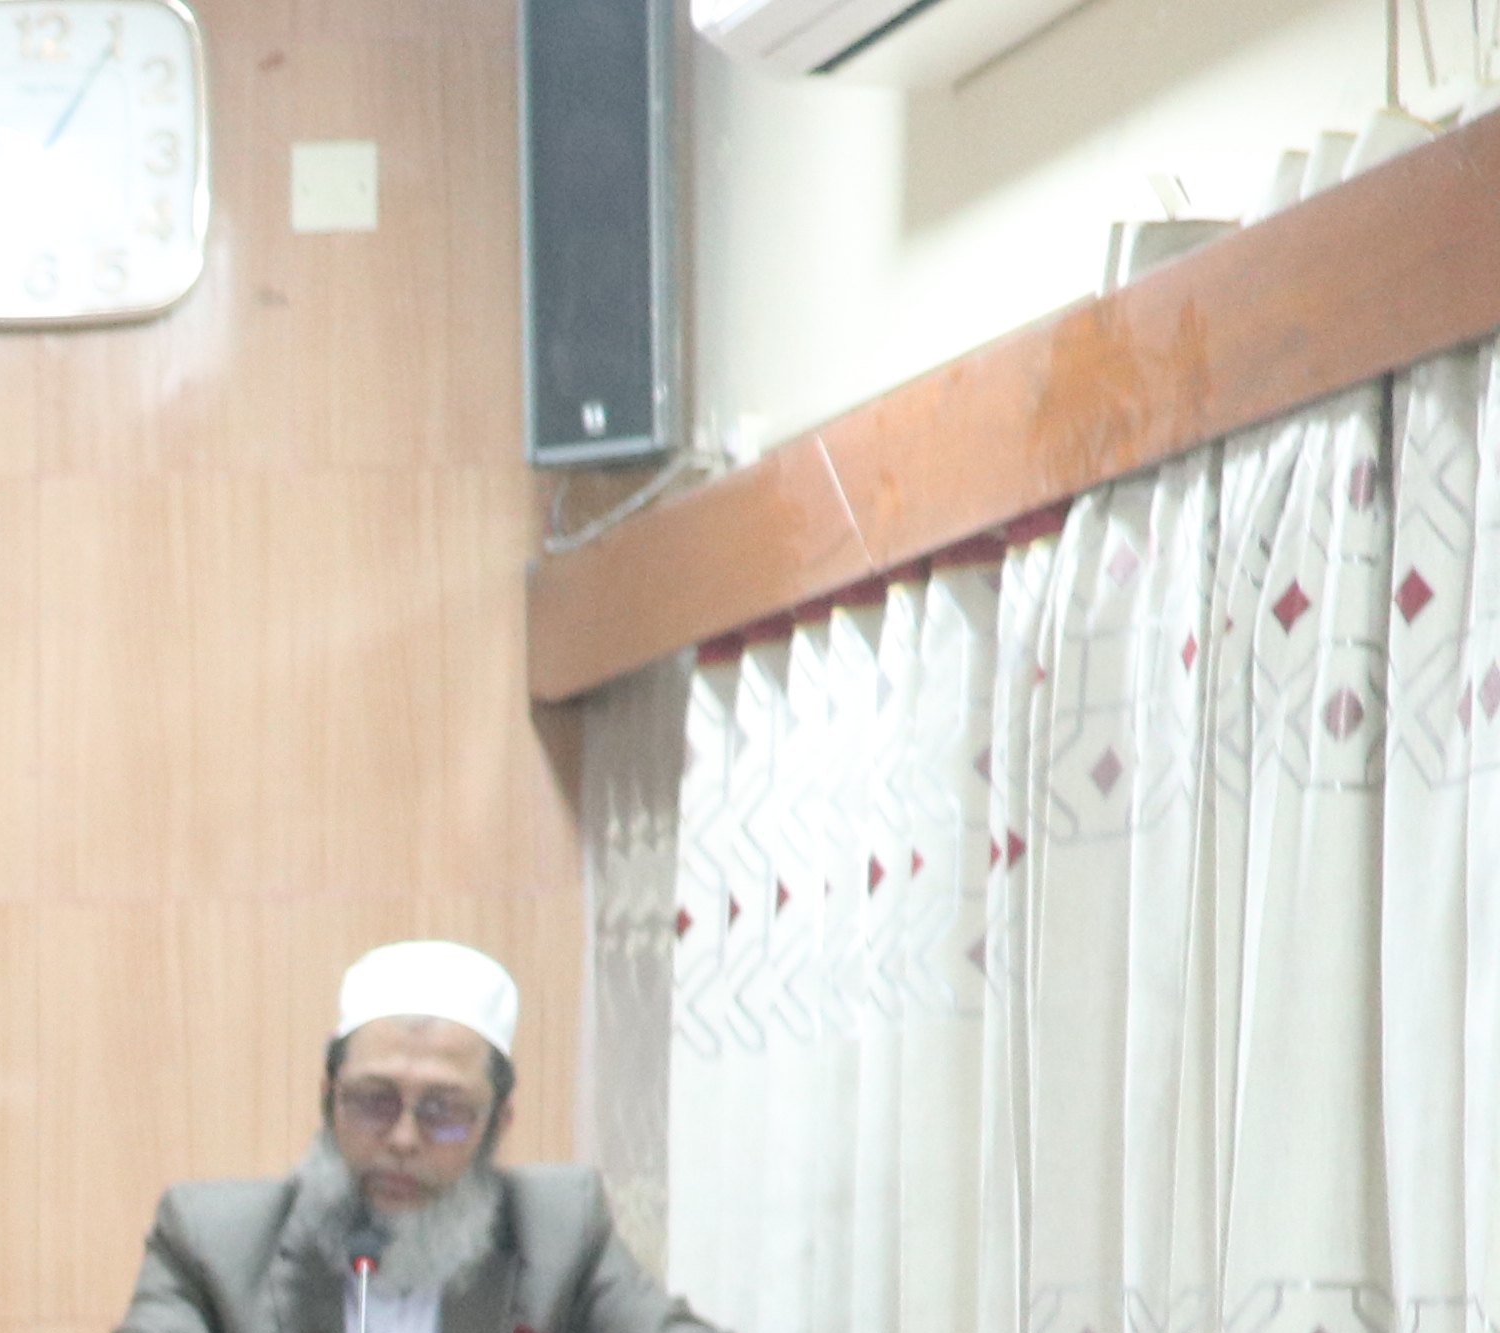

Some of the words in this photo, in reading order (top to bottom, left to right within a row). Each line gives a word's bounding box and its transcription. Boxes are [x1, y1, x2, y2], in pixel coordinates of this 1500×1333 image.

[13, 7, 75, 64] 12
[139, 53, 182, 107] 2
[143, 128, 185, 180] 3
[92, 246, 131, 297] 5
